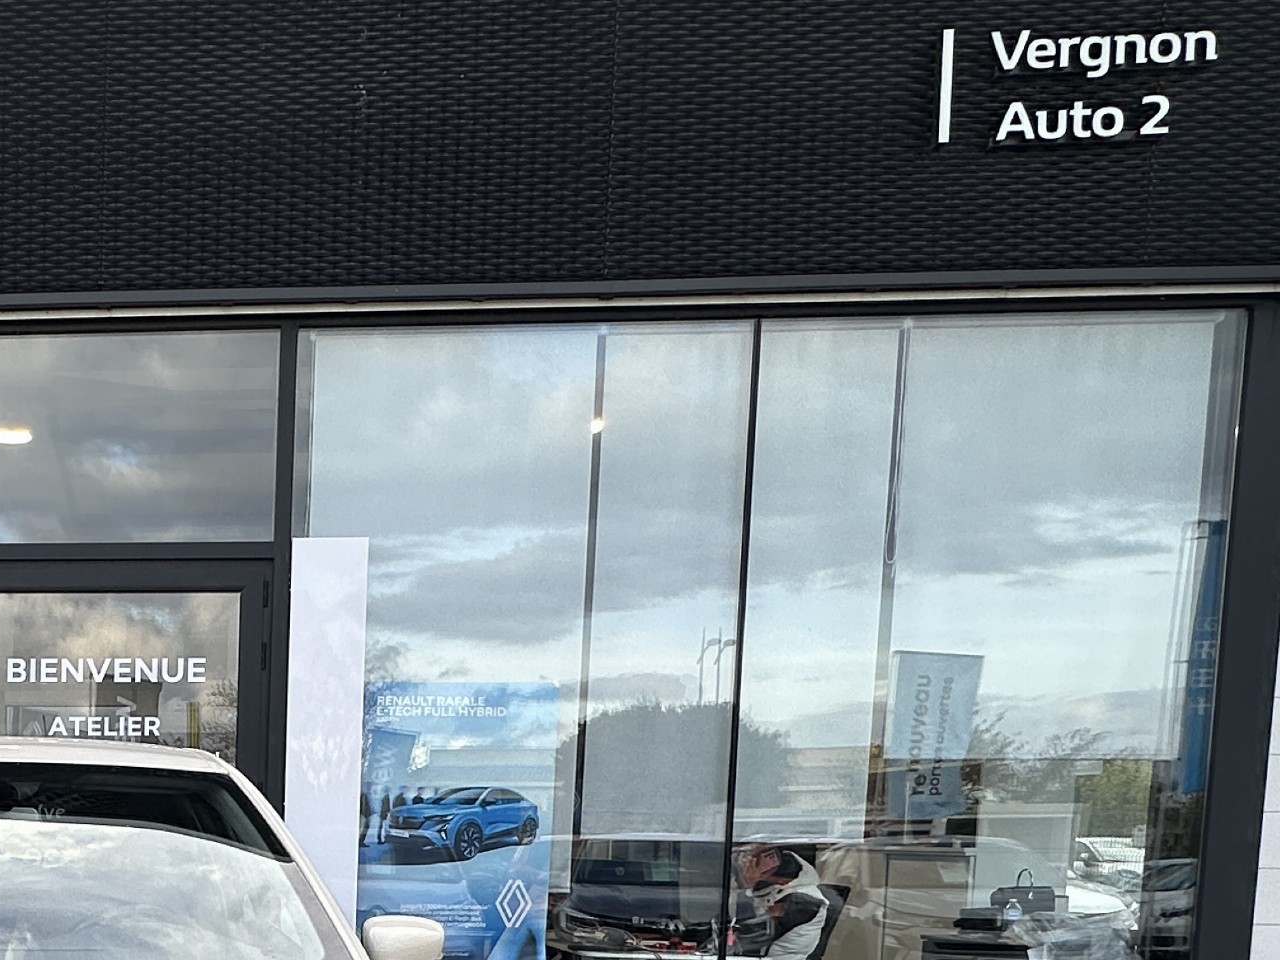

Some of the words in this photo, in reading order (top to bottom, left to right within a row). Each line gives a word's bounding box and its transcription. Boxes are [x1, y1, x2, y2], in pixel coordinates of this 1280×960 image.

[991, 29, 1218, 78] Vergnon
[995, 100, 1124, 141] Auto
[1139, 95, 1170, 135] 2
[6, 657, 207, 684] BIENVENUE
[377, 695, 435, 707] RENAULT
[436, 696, 486, 707] RAFALE
[424, 707, 456, 717] FULL
[459, 707, 507, 718] HYBRID
[48, 716, 161, 737] ATELIER
